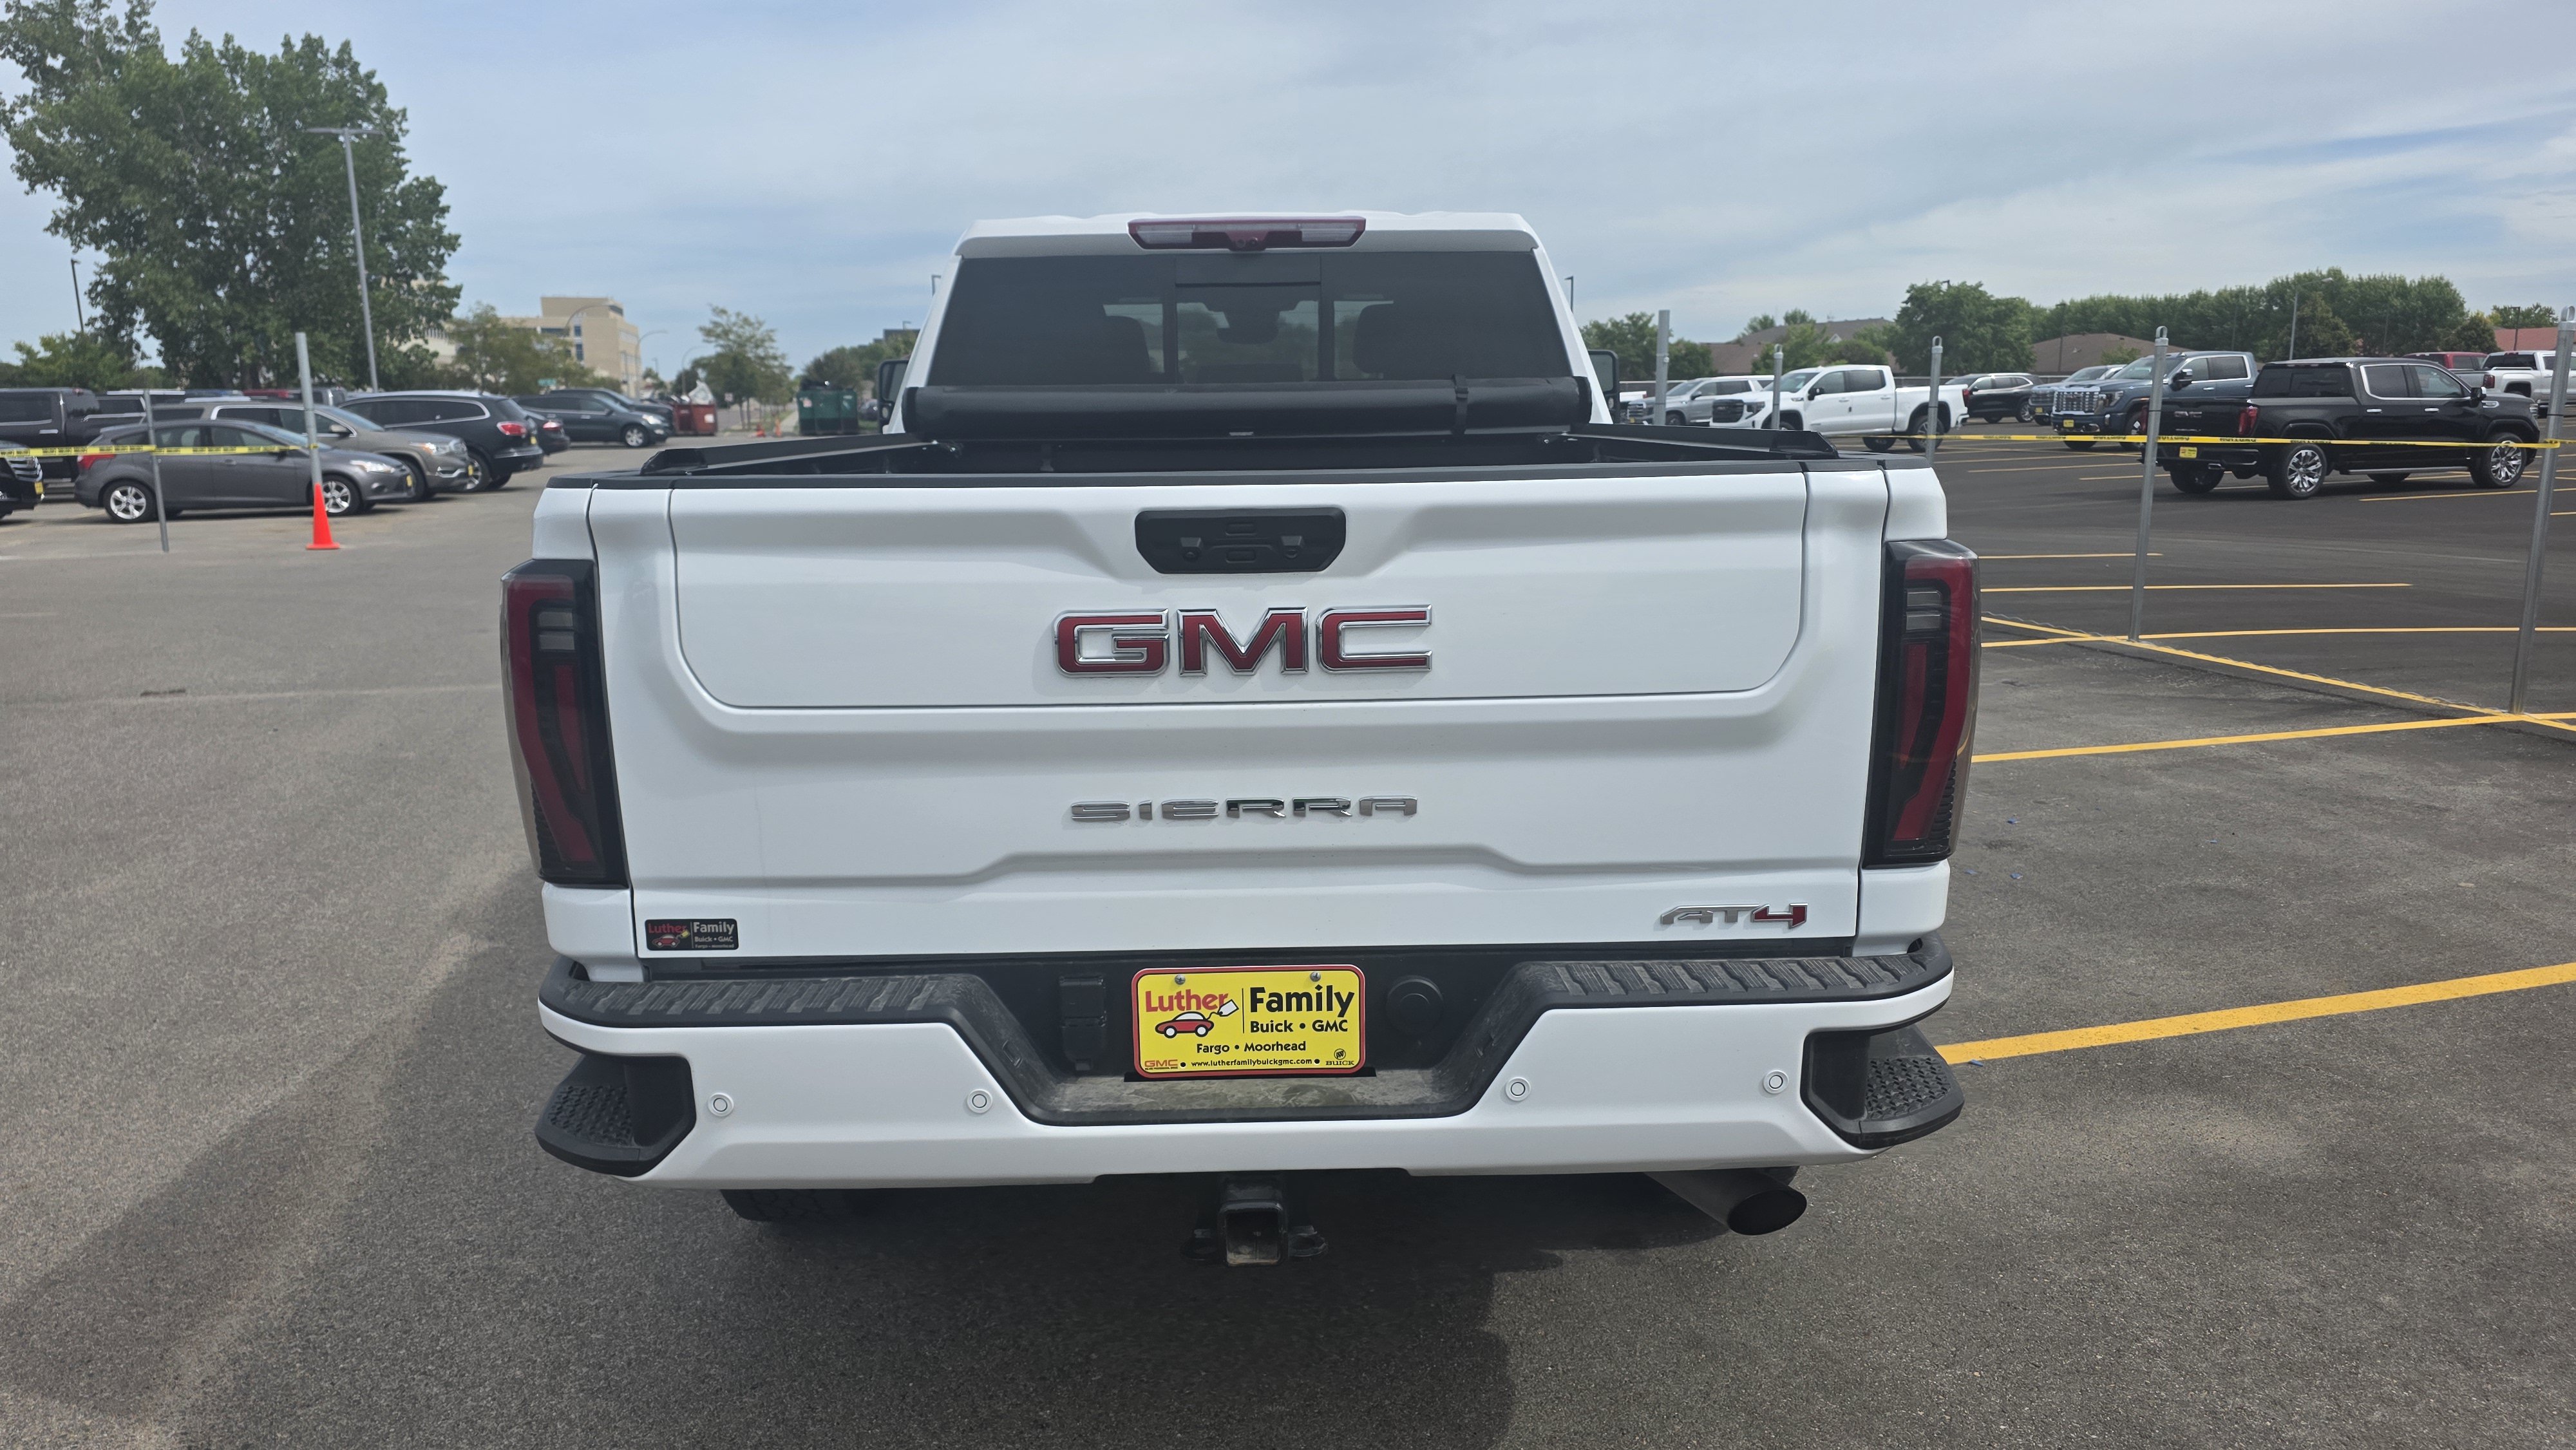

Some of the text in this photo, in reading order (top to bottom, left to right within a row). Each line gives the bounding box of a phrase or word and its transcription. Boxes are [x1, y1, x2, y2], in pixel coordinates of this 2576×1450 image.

[1054, 604, 1432, 678] GMC
[1070, 795, 1417, 820] SIERRA
[1660, 903, 1808, 929] AT4
[649, 923, 687, 934] Luther
[694, 921, 734, 934] Family
[1145, 988, 1229, 1012] Luther
[1250, 984, 1355, 1017] Family
[1251, 1020, 1348, 1033] Buick GMC
[1197, 1040, 1306, 1055] Fargo Moorhead
[1191, 1059, 1312, 1067] www.lutherfamilybuickgmc.com
